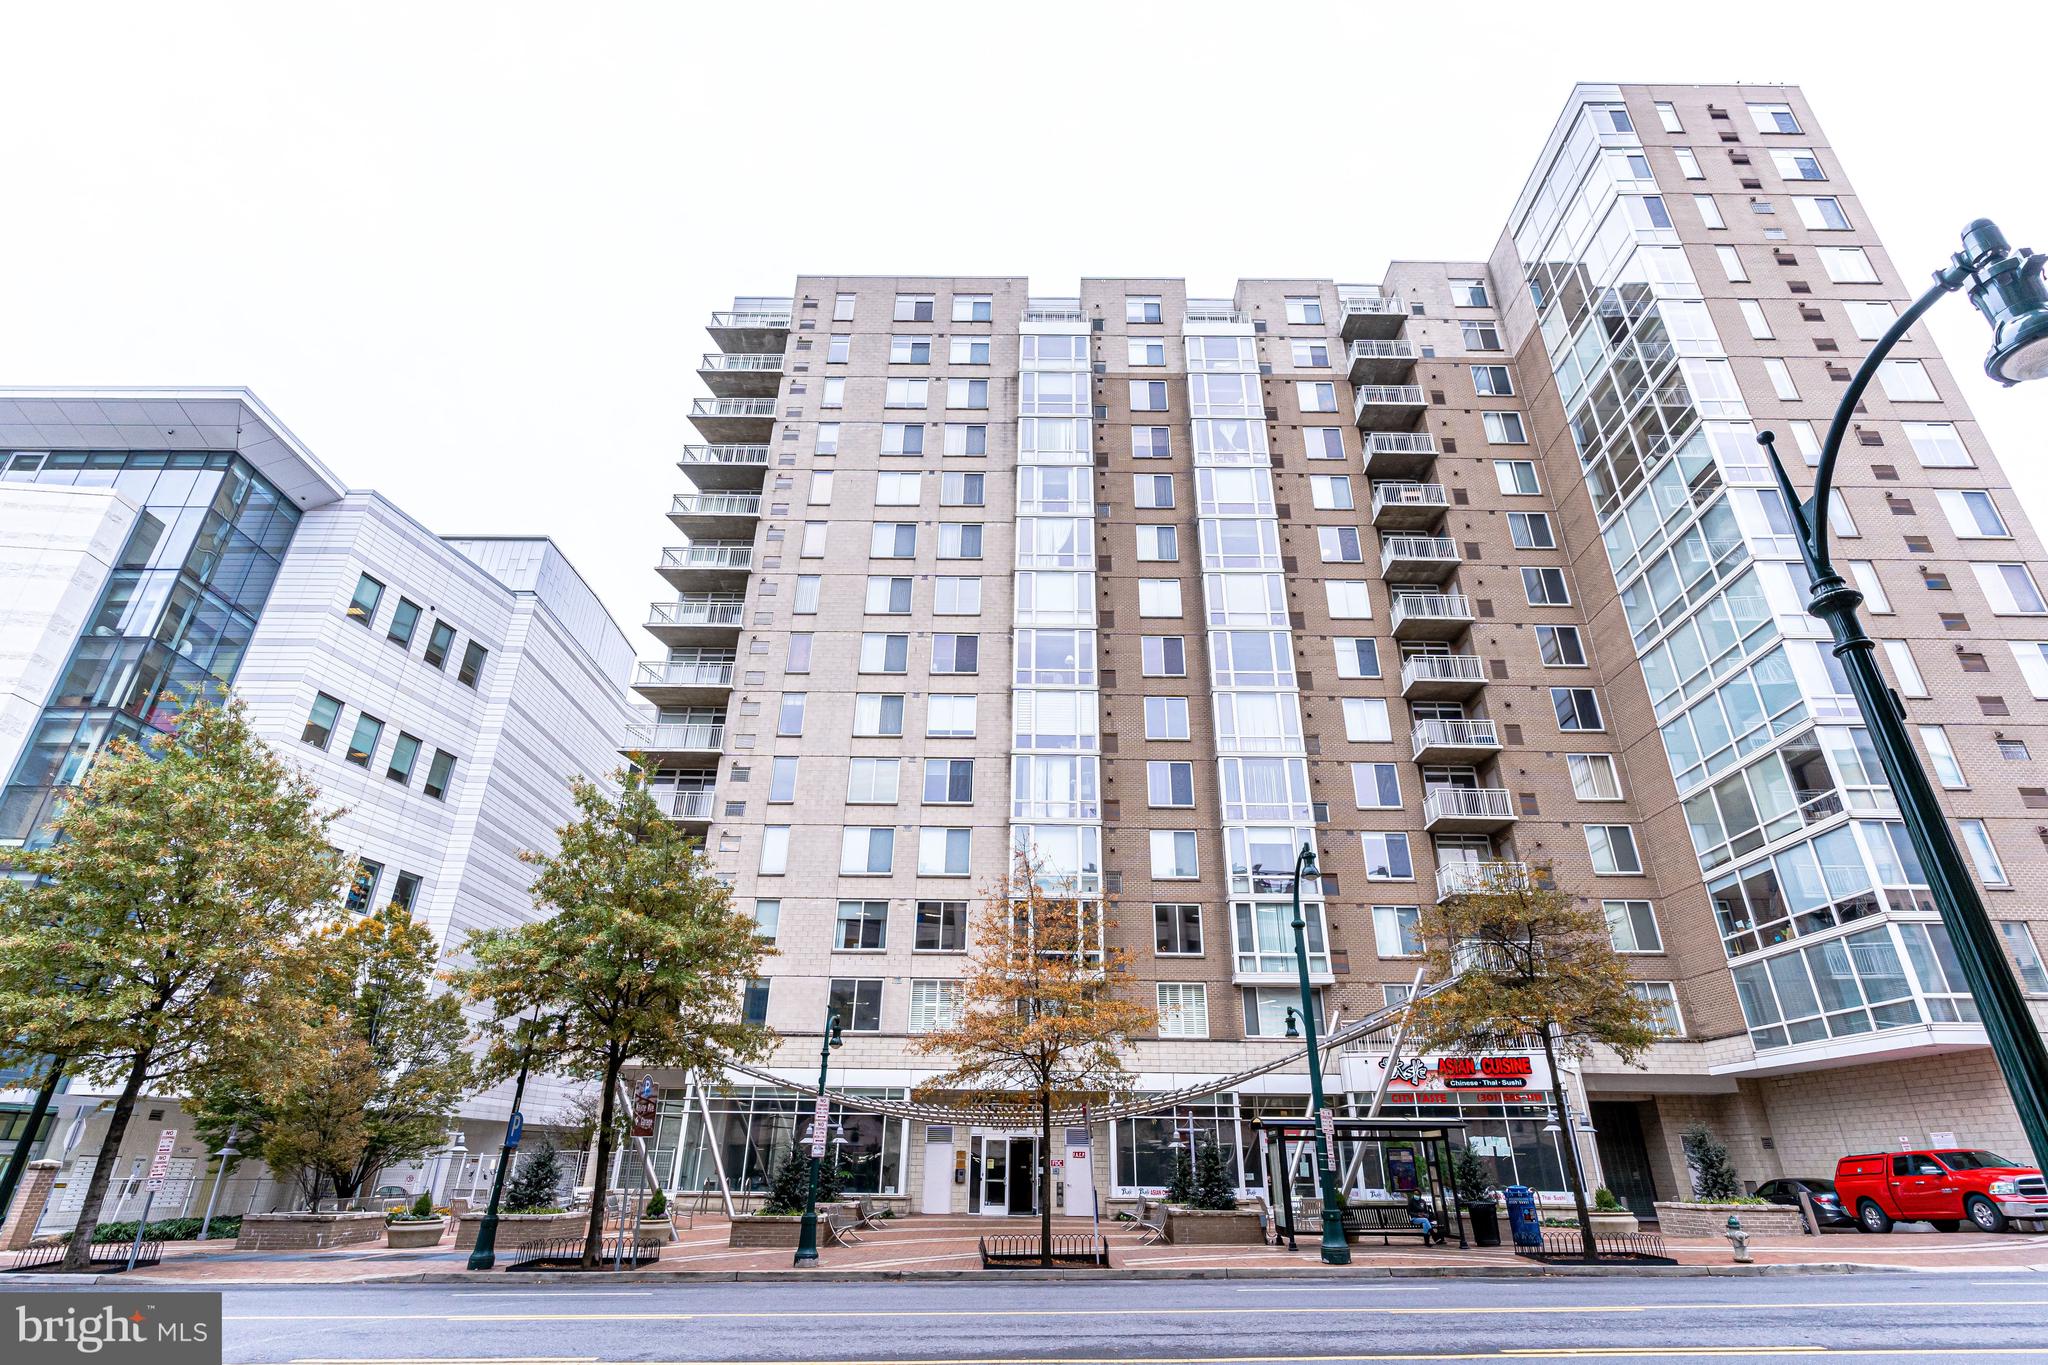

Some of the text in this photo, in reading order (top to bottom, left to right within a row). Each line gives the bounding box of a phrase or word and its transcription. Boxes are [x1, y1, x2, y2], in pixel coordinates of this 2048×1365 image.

[1438, 1057, 1532, 1075] ASIAN CUISINE
[1482, 1079, 1498, 1087] Thai
[1501, 1079, 1522, 1087] Sushi
[1391, 1093, 1447, 1103] CITY TASTE
[511, 1115, 521, 1137] P
